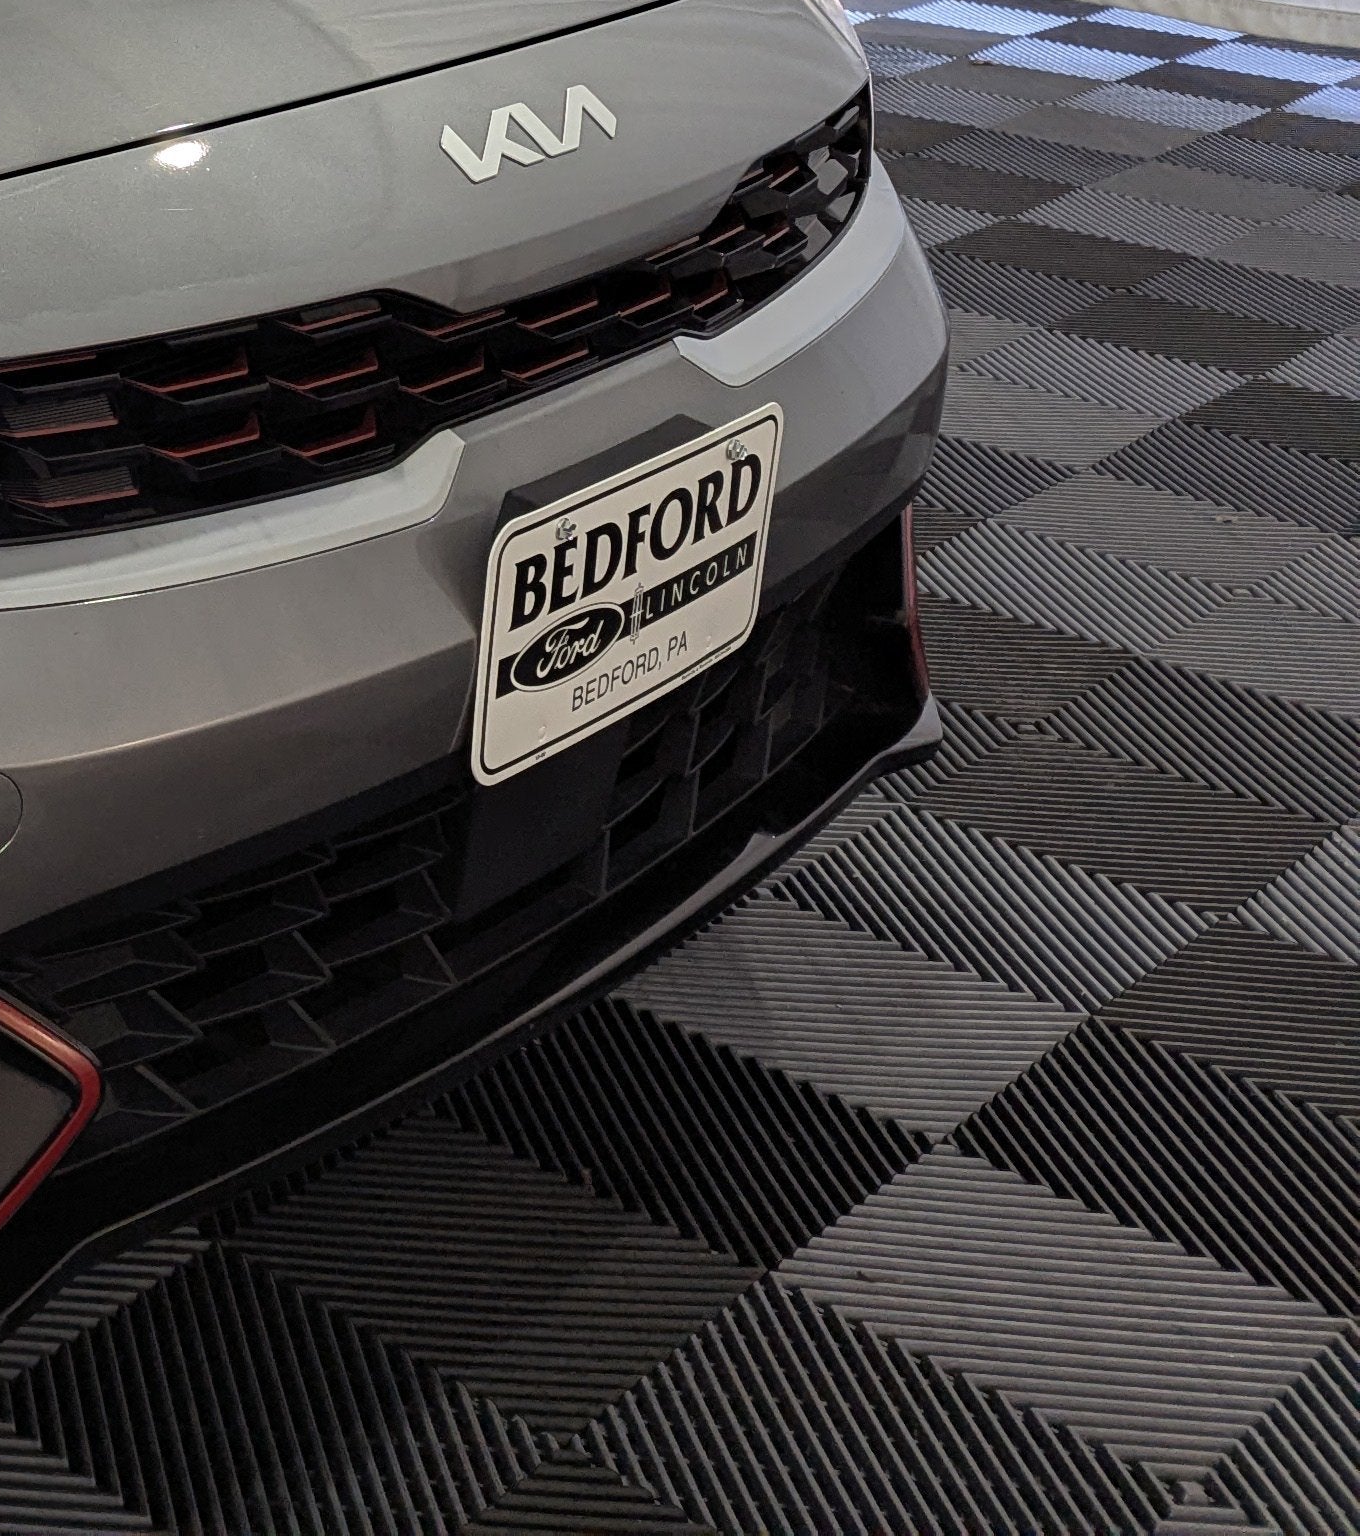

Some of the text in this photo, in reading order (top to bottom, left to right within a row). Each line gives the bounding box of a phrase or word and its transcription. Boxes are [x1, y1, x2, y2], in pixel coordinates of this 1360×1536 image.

[440, 84, 617, 183] KIA
[508, 453, 762, 632] BEDFORD
[536, 617, 605, 678] Ford
[645, 543, 749, 620] LINCOLN
[571, 649, 662, 713] BEDFORD,
[667, 630, 689, 664] PA
